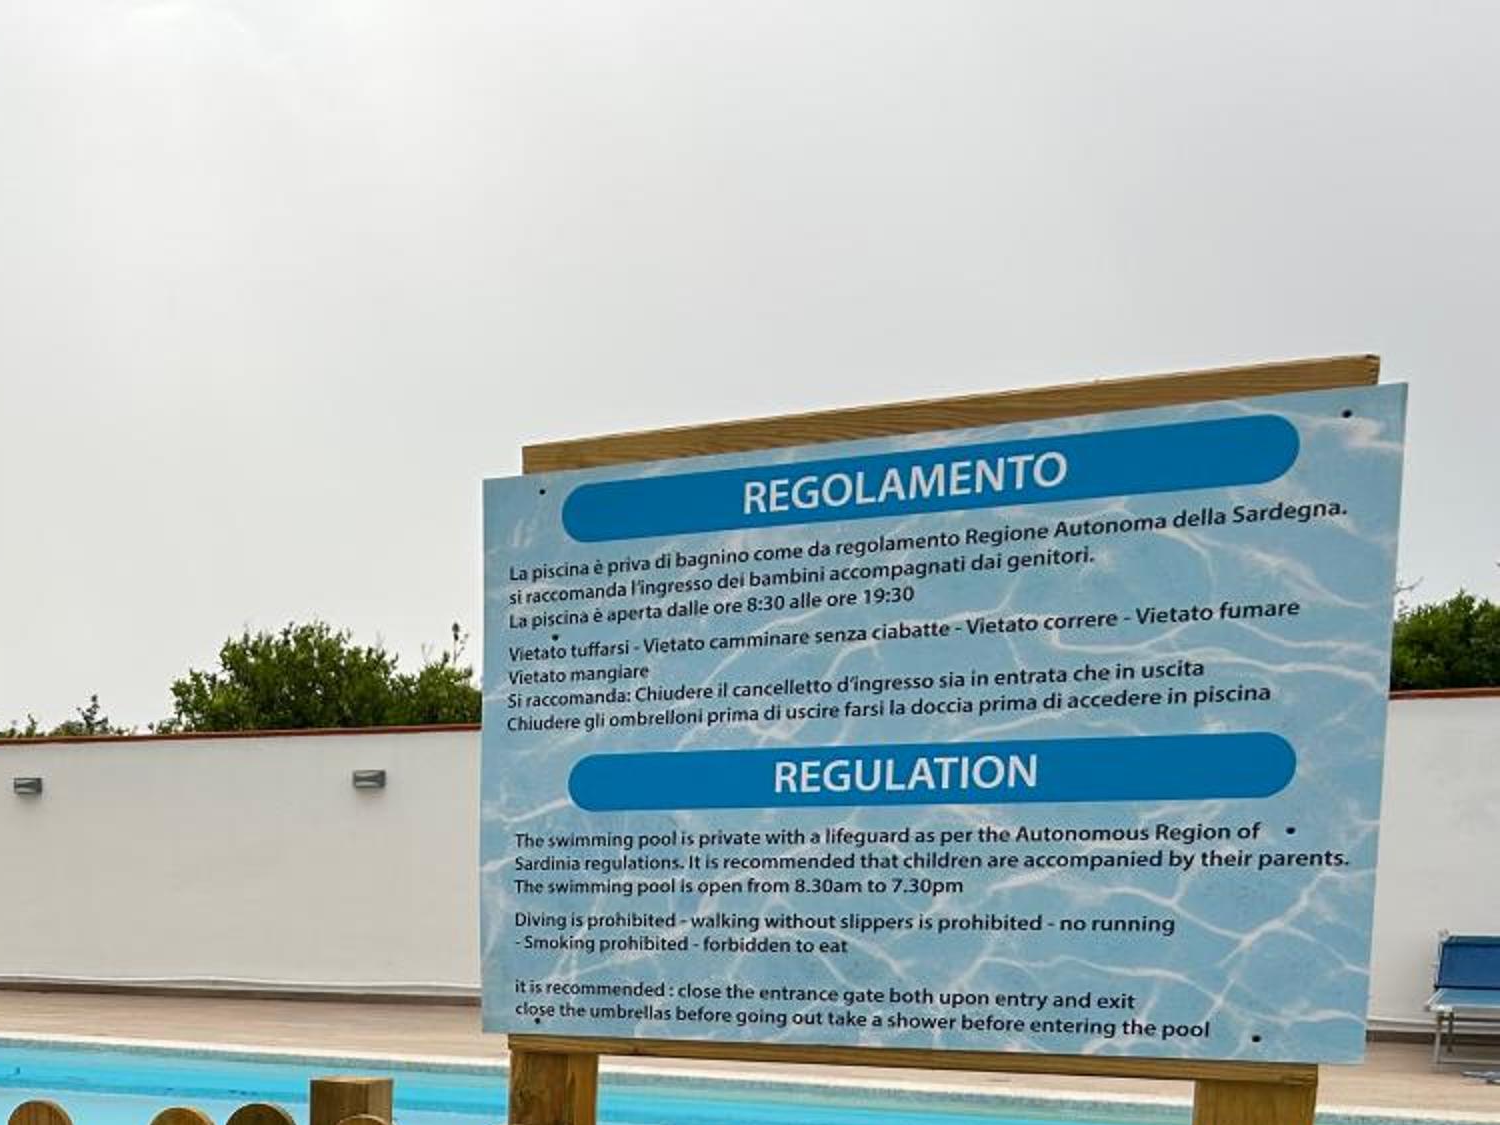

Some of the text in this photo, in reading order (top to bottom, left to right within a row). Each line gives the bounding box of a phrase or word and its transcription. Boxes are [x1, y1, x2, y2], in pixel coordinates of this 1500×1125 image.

[743, 451, 1068, 515] REGOLAMENTO
[509, 500, 1347, 584] La piscina è priva di bagnino come da regolamento Regione Autonoma della Sardegna.
[508, 588, 523, 606] si
[525, 580, 627, 604] raccomanda
[716, 570, 745, 590] dei
[749, 564, 825, 587] bambini
[829, 554, 966, 581] accompagnati
[970, 551, 1002, 571] dai
[1007, 544, 1095, 573] genitori.
[509, 584, 915, 631] La piscina è aperta dalle ore 8:30 alle ore 19:30
[509, 644, 567, 662] Vietato
[570, 638, 629, 658] tuffarsi
[643, 636, 705, 654] Vietato
[709, 629, 810, 650] camminare
[814, 628, 867, 644] senza
[871, 620, 951, 641] ciabatte
[965, 613, 1039, 635] Vietato
[1043, 612, 1118, 631] correre
[1135, 604, 1214, 625] Vietato
[1219, 600, 1300, 620] fumare
[507, 692, 522, 709] Si
[525, 686, 631, 708] raccomanda:
[634, 682, 713, 703] Chiudere
[717, 680, 728, 698] il
[731, 677, 833, 698] cancelletto
[939, 670, 965, 689] sia
[970, 668, 989, 687] in
[993, 667, 1067, 686] entrata
[1073, 662, 1110, 682] che
[1115, 662, 1135, 680] in
[1141, 658, 1204, 679] uscita
[508, 660, 649, 686] Vietato mangiare
[507, 683, 1271, 733] Chiudere gli ombrelloni prima di uscire farsi la doccia prima di accedere in piscina
[773, 754, 1038, 794] REGULATION
[514, 820, 1262, 851] The swimming pool is private with a lifeguard as per the Autonomous Region of
[515, 848, 1349, 874] Sardinia regulations. It is recommended that children are accompanied by their parents.
[513, 874, 963, 897] The swimming pool is open from 8.30am to 7.30pm
[515, 911, 567, 931] Diving
[570, 911, 584, 928] is
[587, 911, 676, 934] prohibited
[689, 911, 760, 934] walking
[763, 911, 836, 929] without
[838, 912, 913, 934] slippers
[919, 912, 933, 931] is
[937, 912, 1043, 934] prohibited
[1059, 918, 1087, 931] no
[1091, 914, 1175, 937] running
[523, 933, 595, 955] Smoking
[599, 934, 689, 954] prohibited
[703, 934, 791, 953] forbidden
[795, 933, 815, 953] to
[818, 939, 848, 954] eat
[515, 978, 526, 994] it
[529, 978, 542, 994] is
[545, 978, 665, 997] recommended
[677, 981, 722, 999] close
[725, 982, 755, 1000] the
[759, 984, 838, 1002] entrance
[843, 987, 885, 1007] gate
[889, 986, 934, 1005] both
[939, 992, 989, 1009] upon
[995, 991, 1050, 1012] entry
[1052, 990, 1091, 1009] and
[1096, 992, 1136, 1010] exit
[515, 999, 1210, 1041] close the umbrellas before going out take a shower before entering the pool
